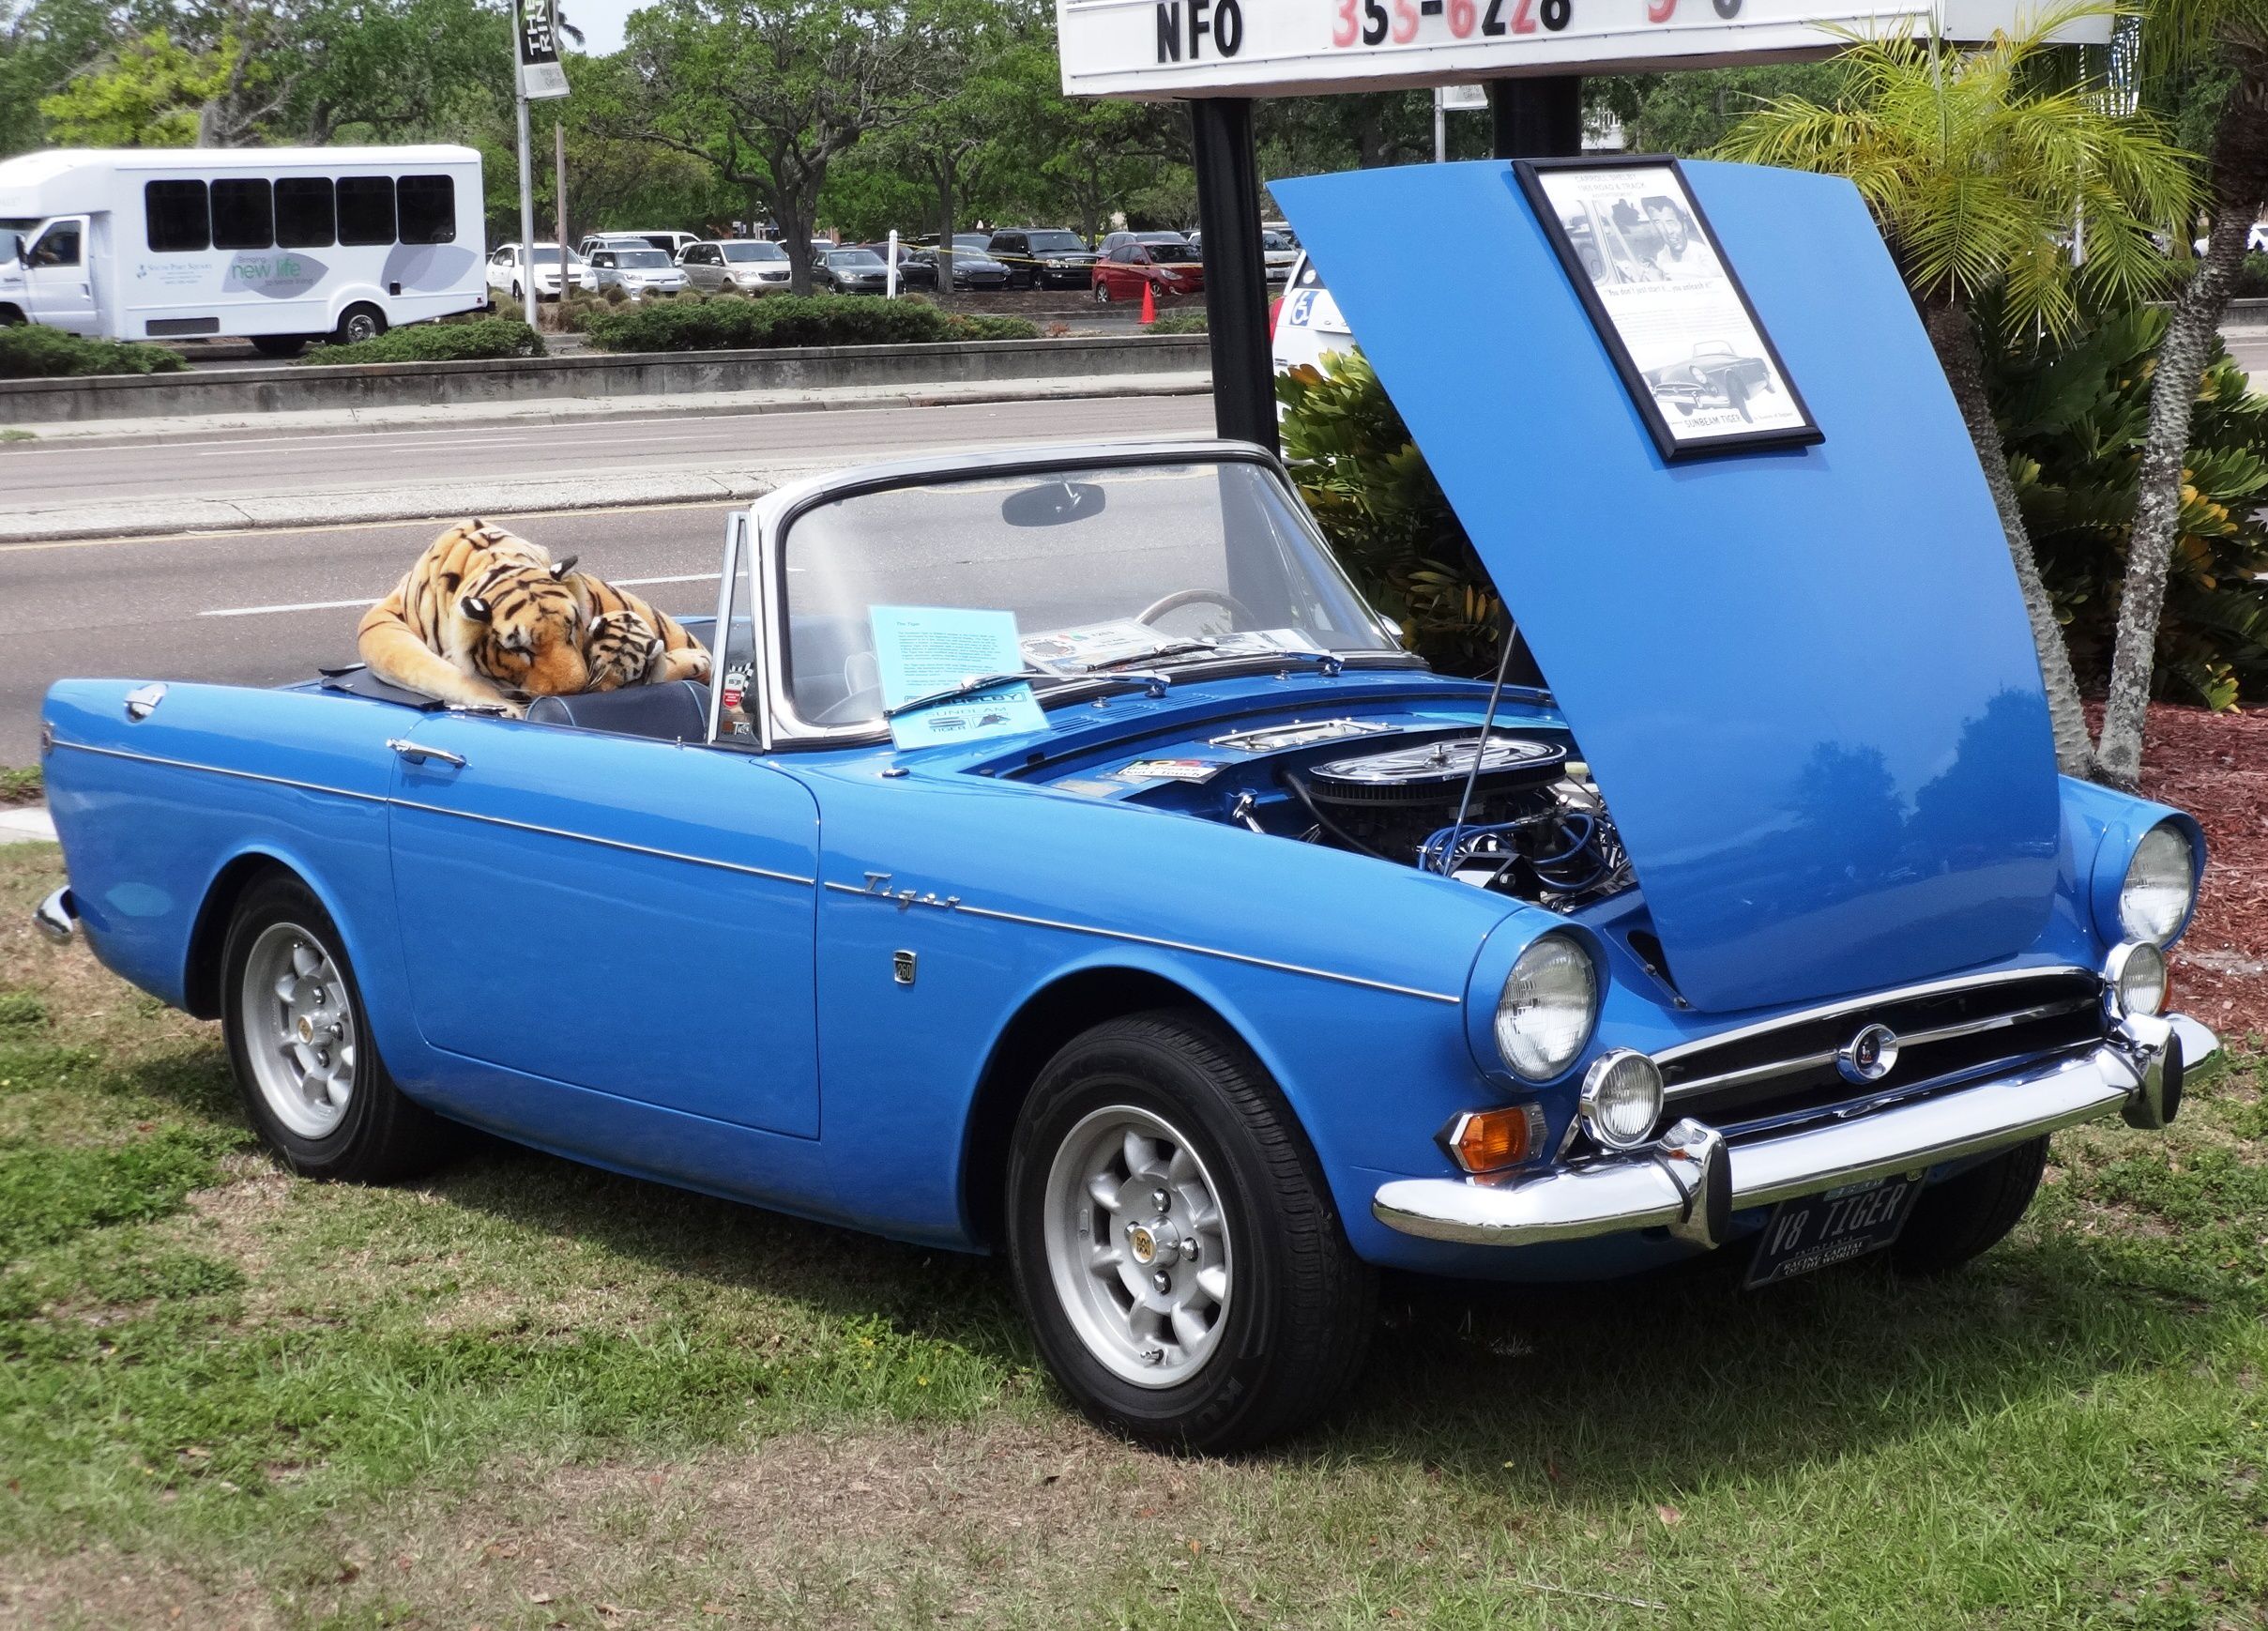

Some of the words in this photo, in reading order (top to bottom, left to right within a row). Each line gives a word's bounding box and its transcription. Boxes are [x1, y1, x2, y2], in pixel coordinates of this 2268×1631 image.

[525, 0, 540, 55] THE
[1157, 0, 1242, 63] NFO
[232, 264, 271, 280] new
[276, 258, 300, 278] life
[1683, 416, 1719, 428] SUNBEAM
[1720, 413, 1742, 424] TIGER
[864, 872, 961, 909] Tiger
[898, 963, 911, 979] 260
[1770, 1210, 1810, 1258] V8
[1819, 1182, 1909, 1240] TIGER
